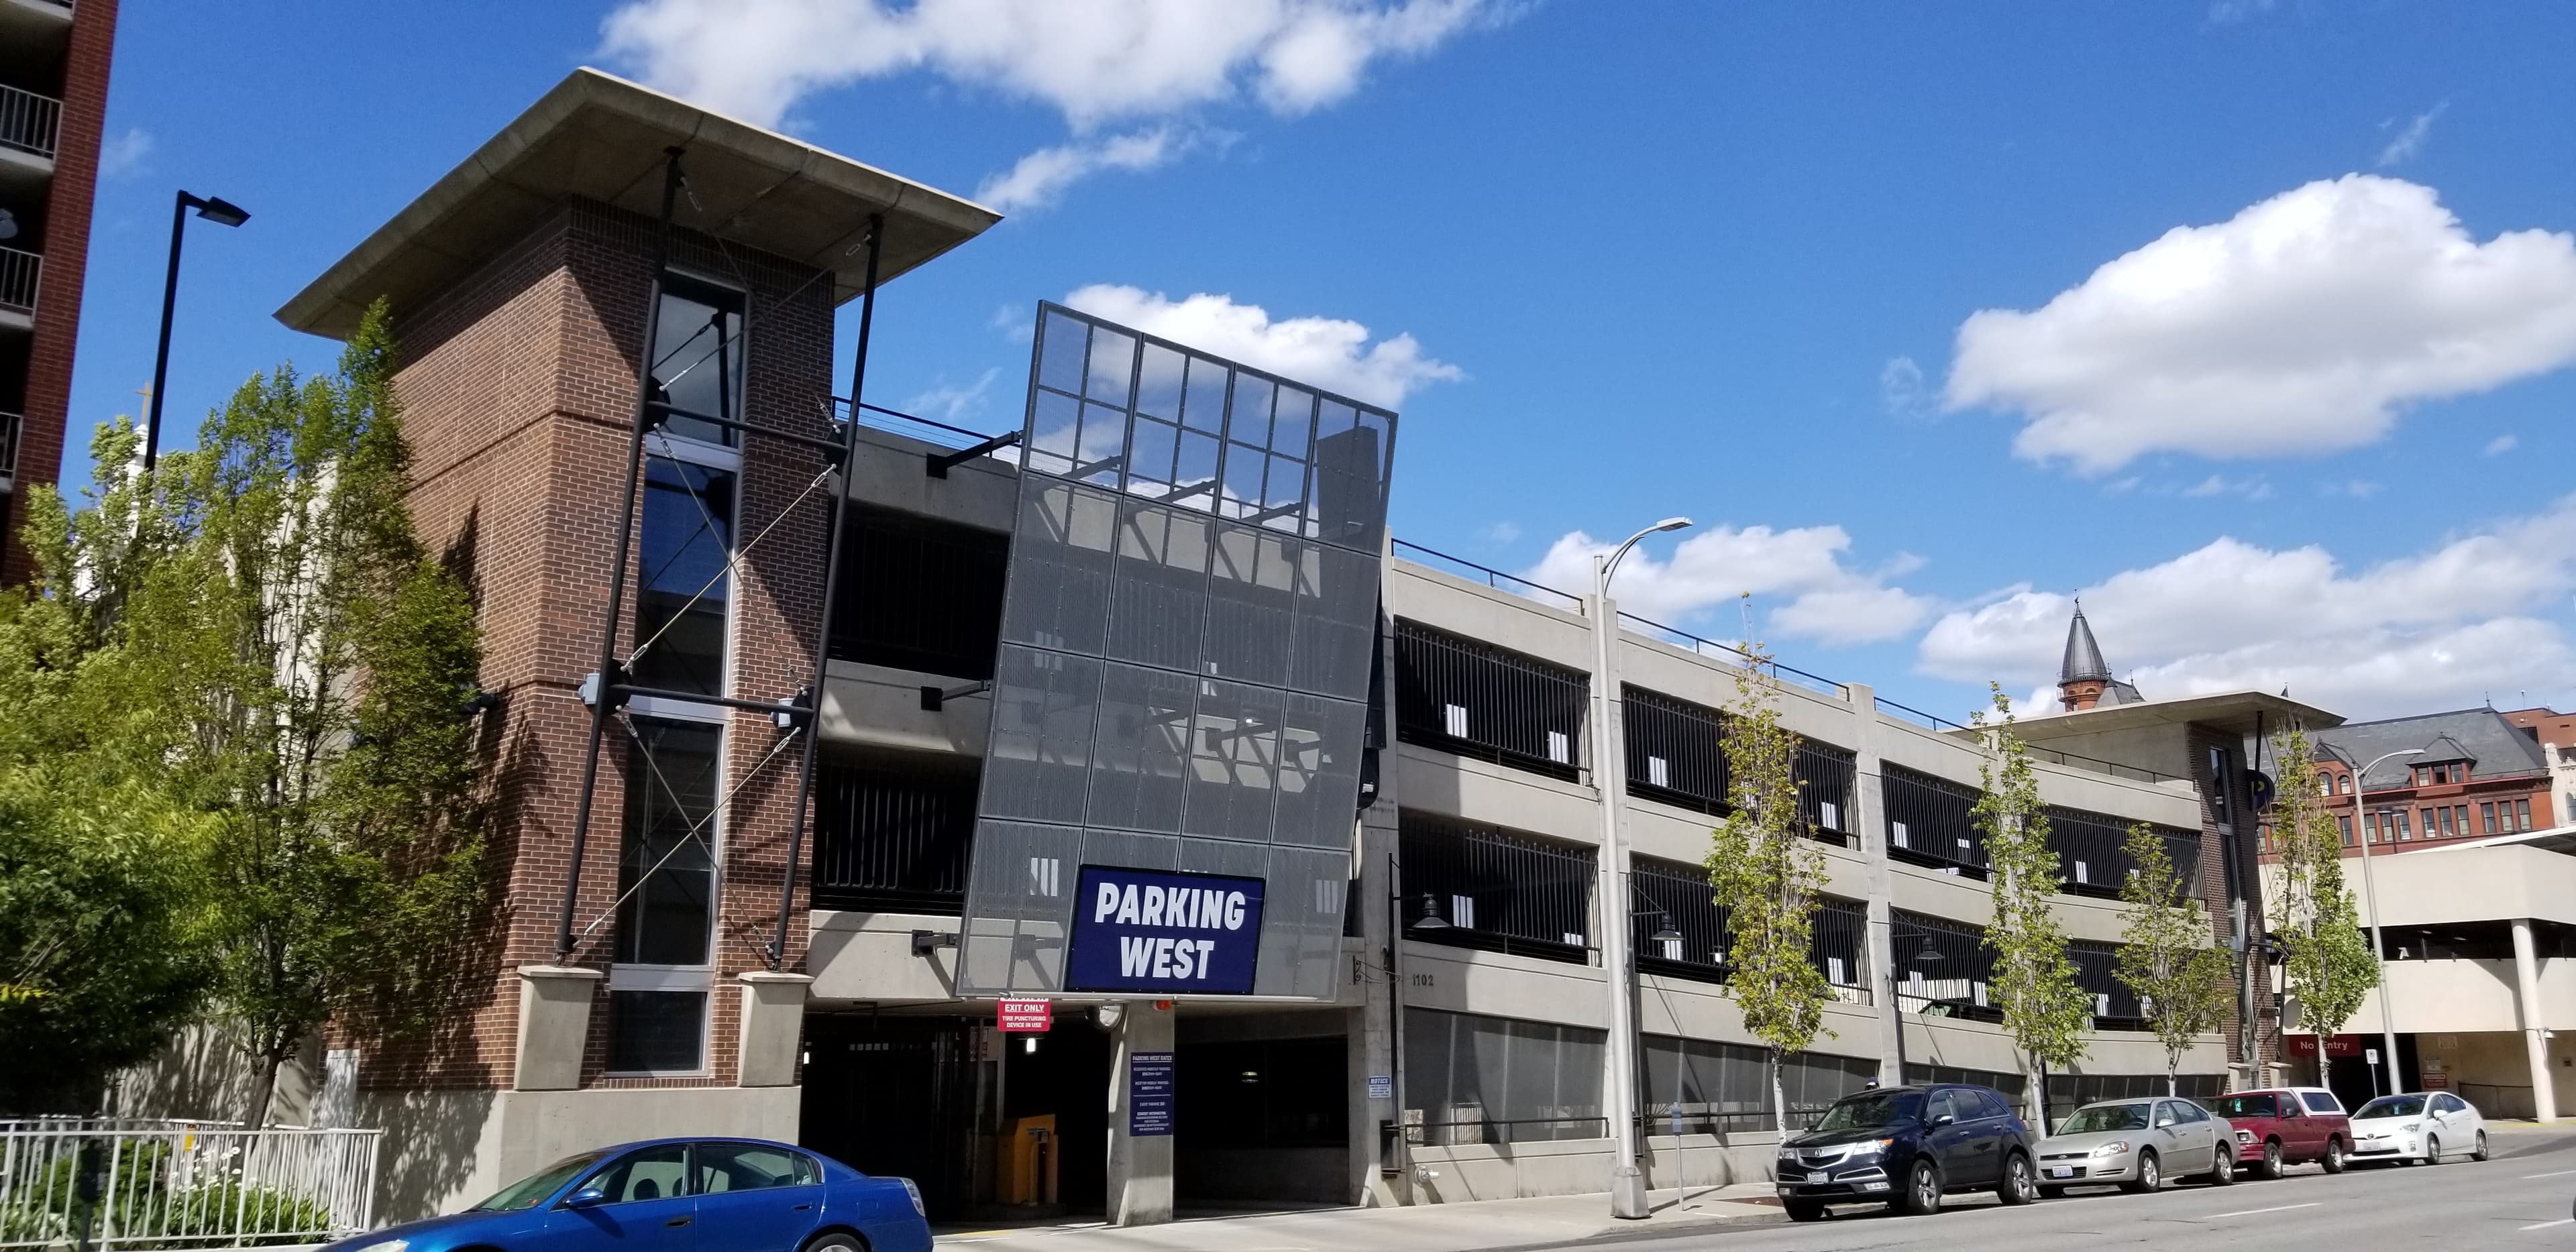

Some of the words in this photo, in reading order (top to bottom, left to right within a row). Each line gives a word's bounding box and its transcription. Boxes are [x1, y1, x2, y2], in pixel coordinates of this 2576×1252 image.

[1095, 882, 1246, 931] PARKING
[1120, 936, 1215, 979] WEST
[1413, 974, 1434, 986] 1102
[1004, 1004, 1022, 1012] EXIT
[1024, 1004, 1044, 1012] ONLY
[2300, 1041, 2314, 1049] No
